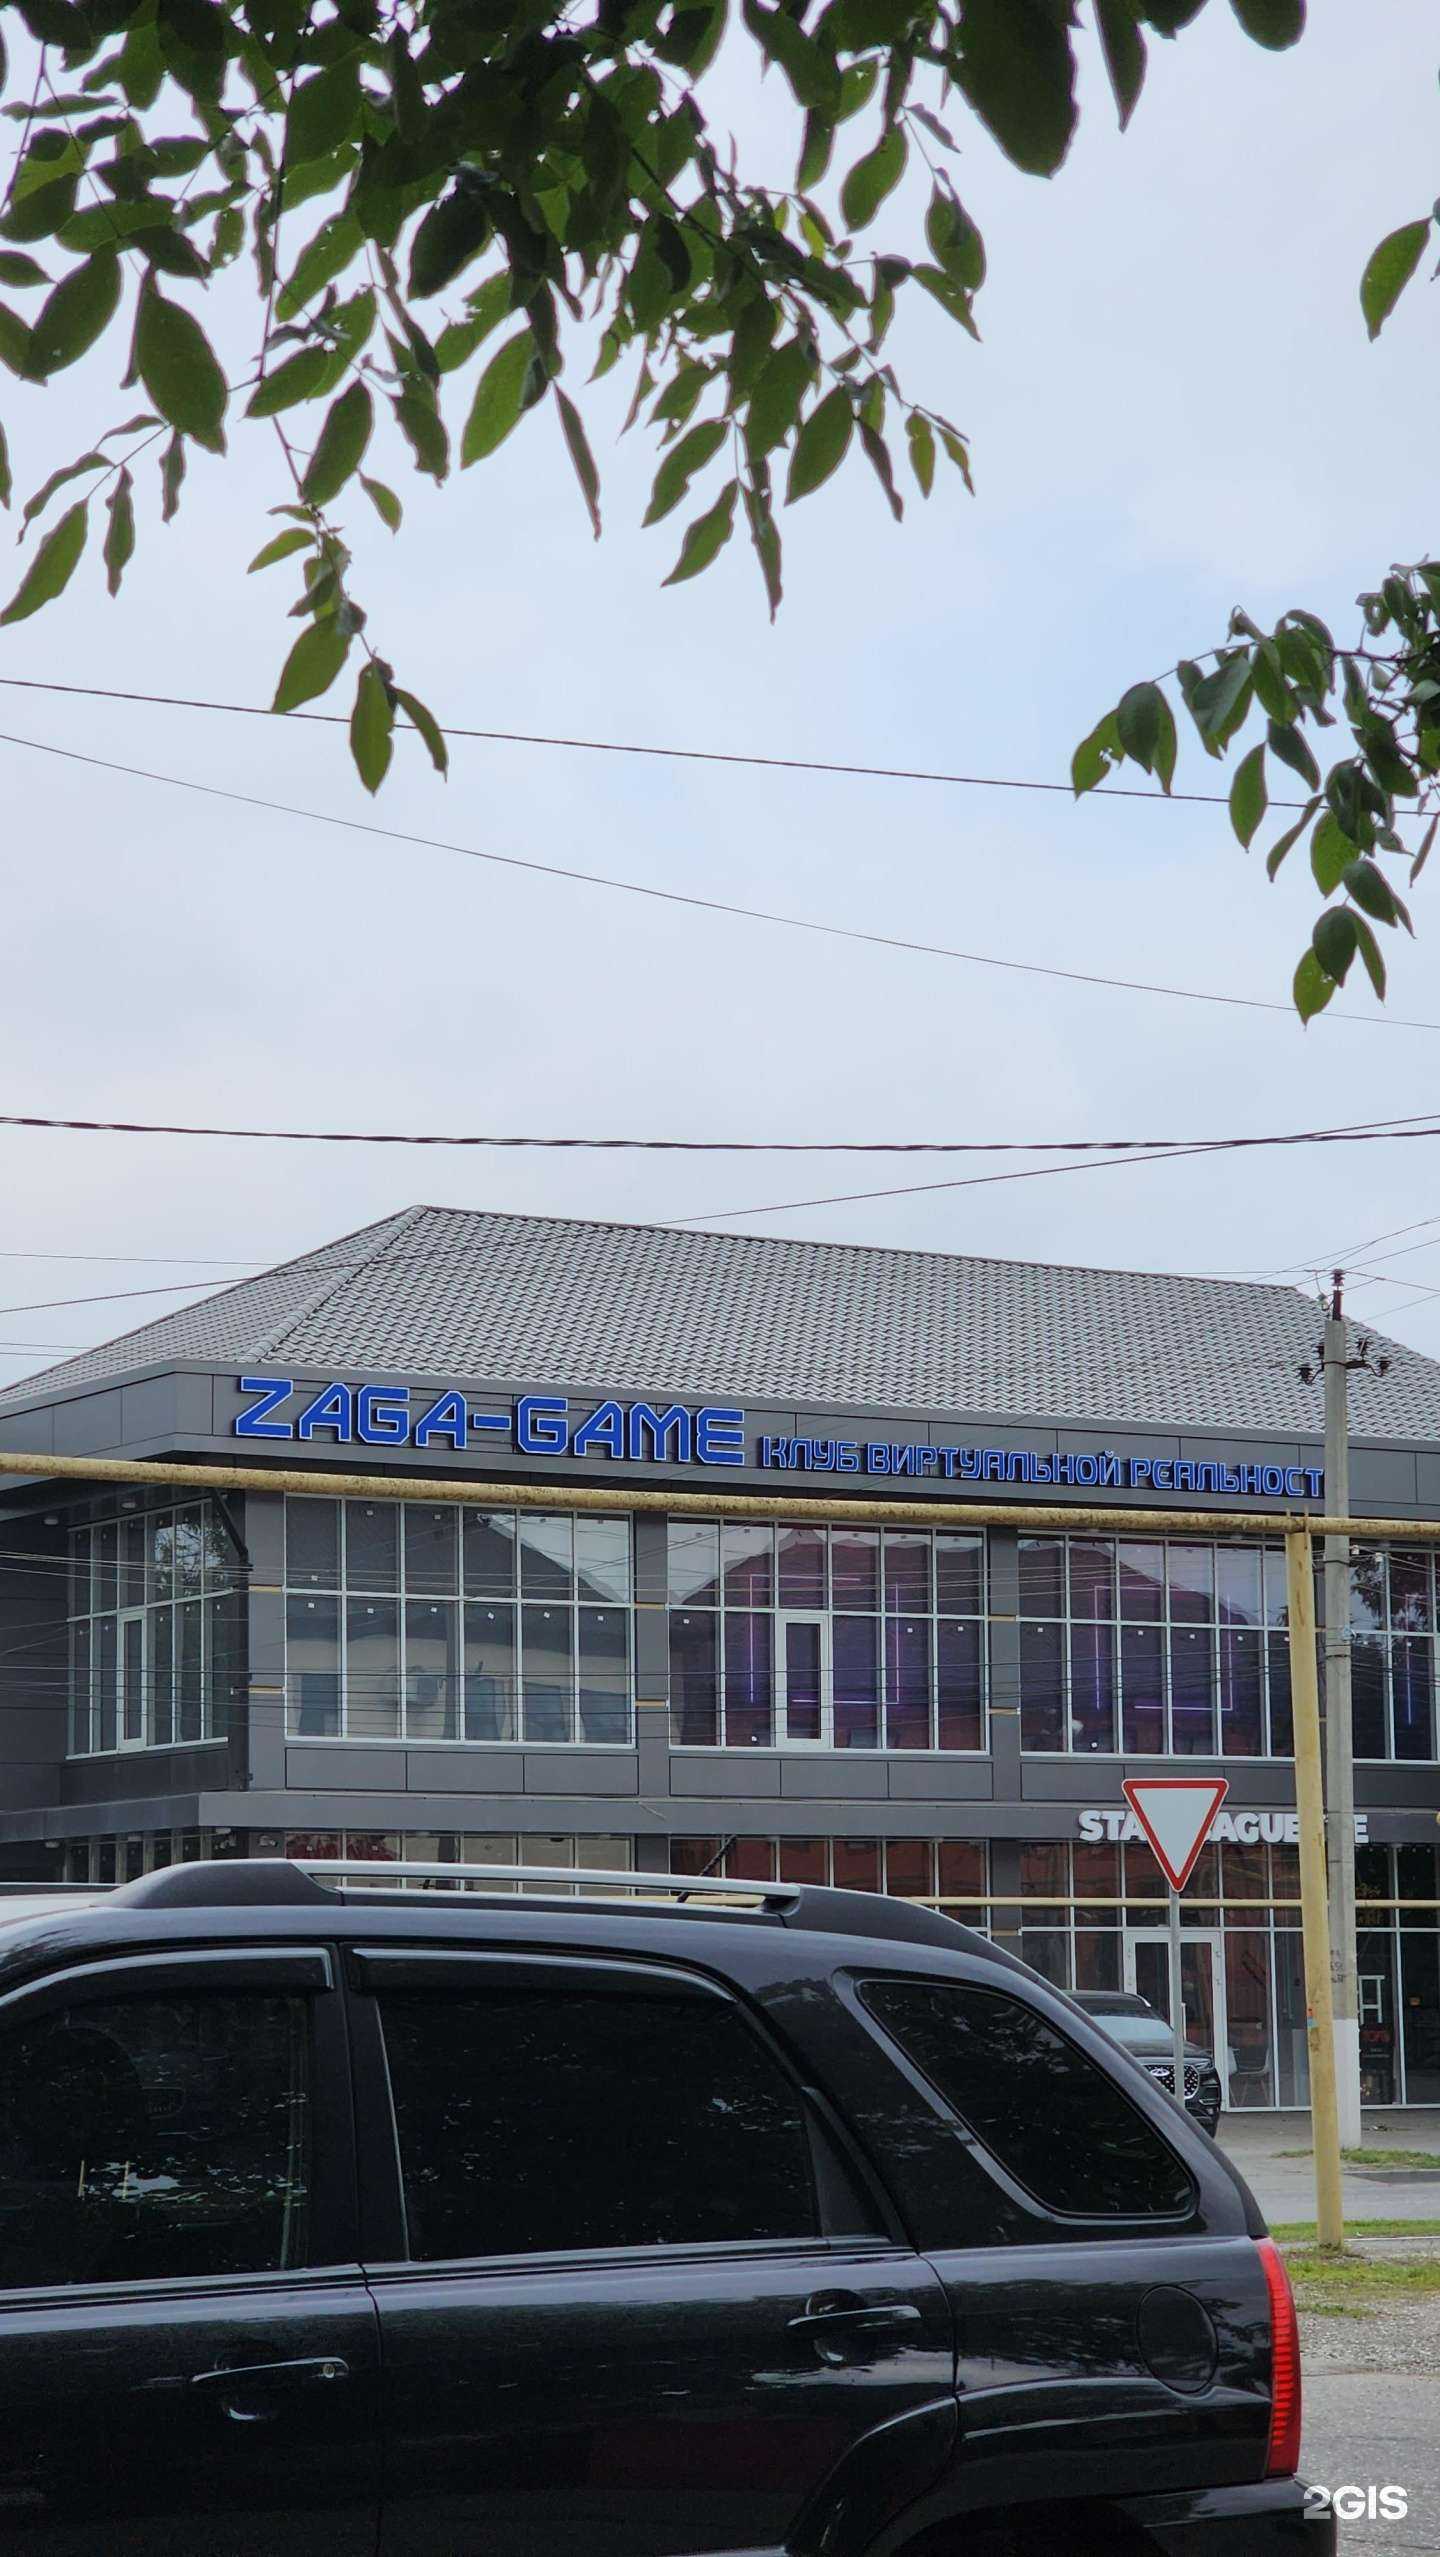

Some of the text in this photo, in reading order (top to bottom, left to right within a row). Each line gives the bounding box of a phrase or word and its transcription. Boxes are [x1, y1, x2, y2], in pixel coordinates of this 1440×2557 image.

[234, 1375, 746, 1467] ZAGA-GAME
[762, 1436, 1324, 1498] КЛУБ ВИРТУАЛЬНОЙ РЕАЛЬНОСТ
[1078, 1809, 1150, 1842] STA
